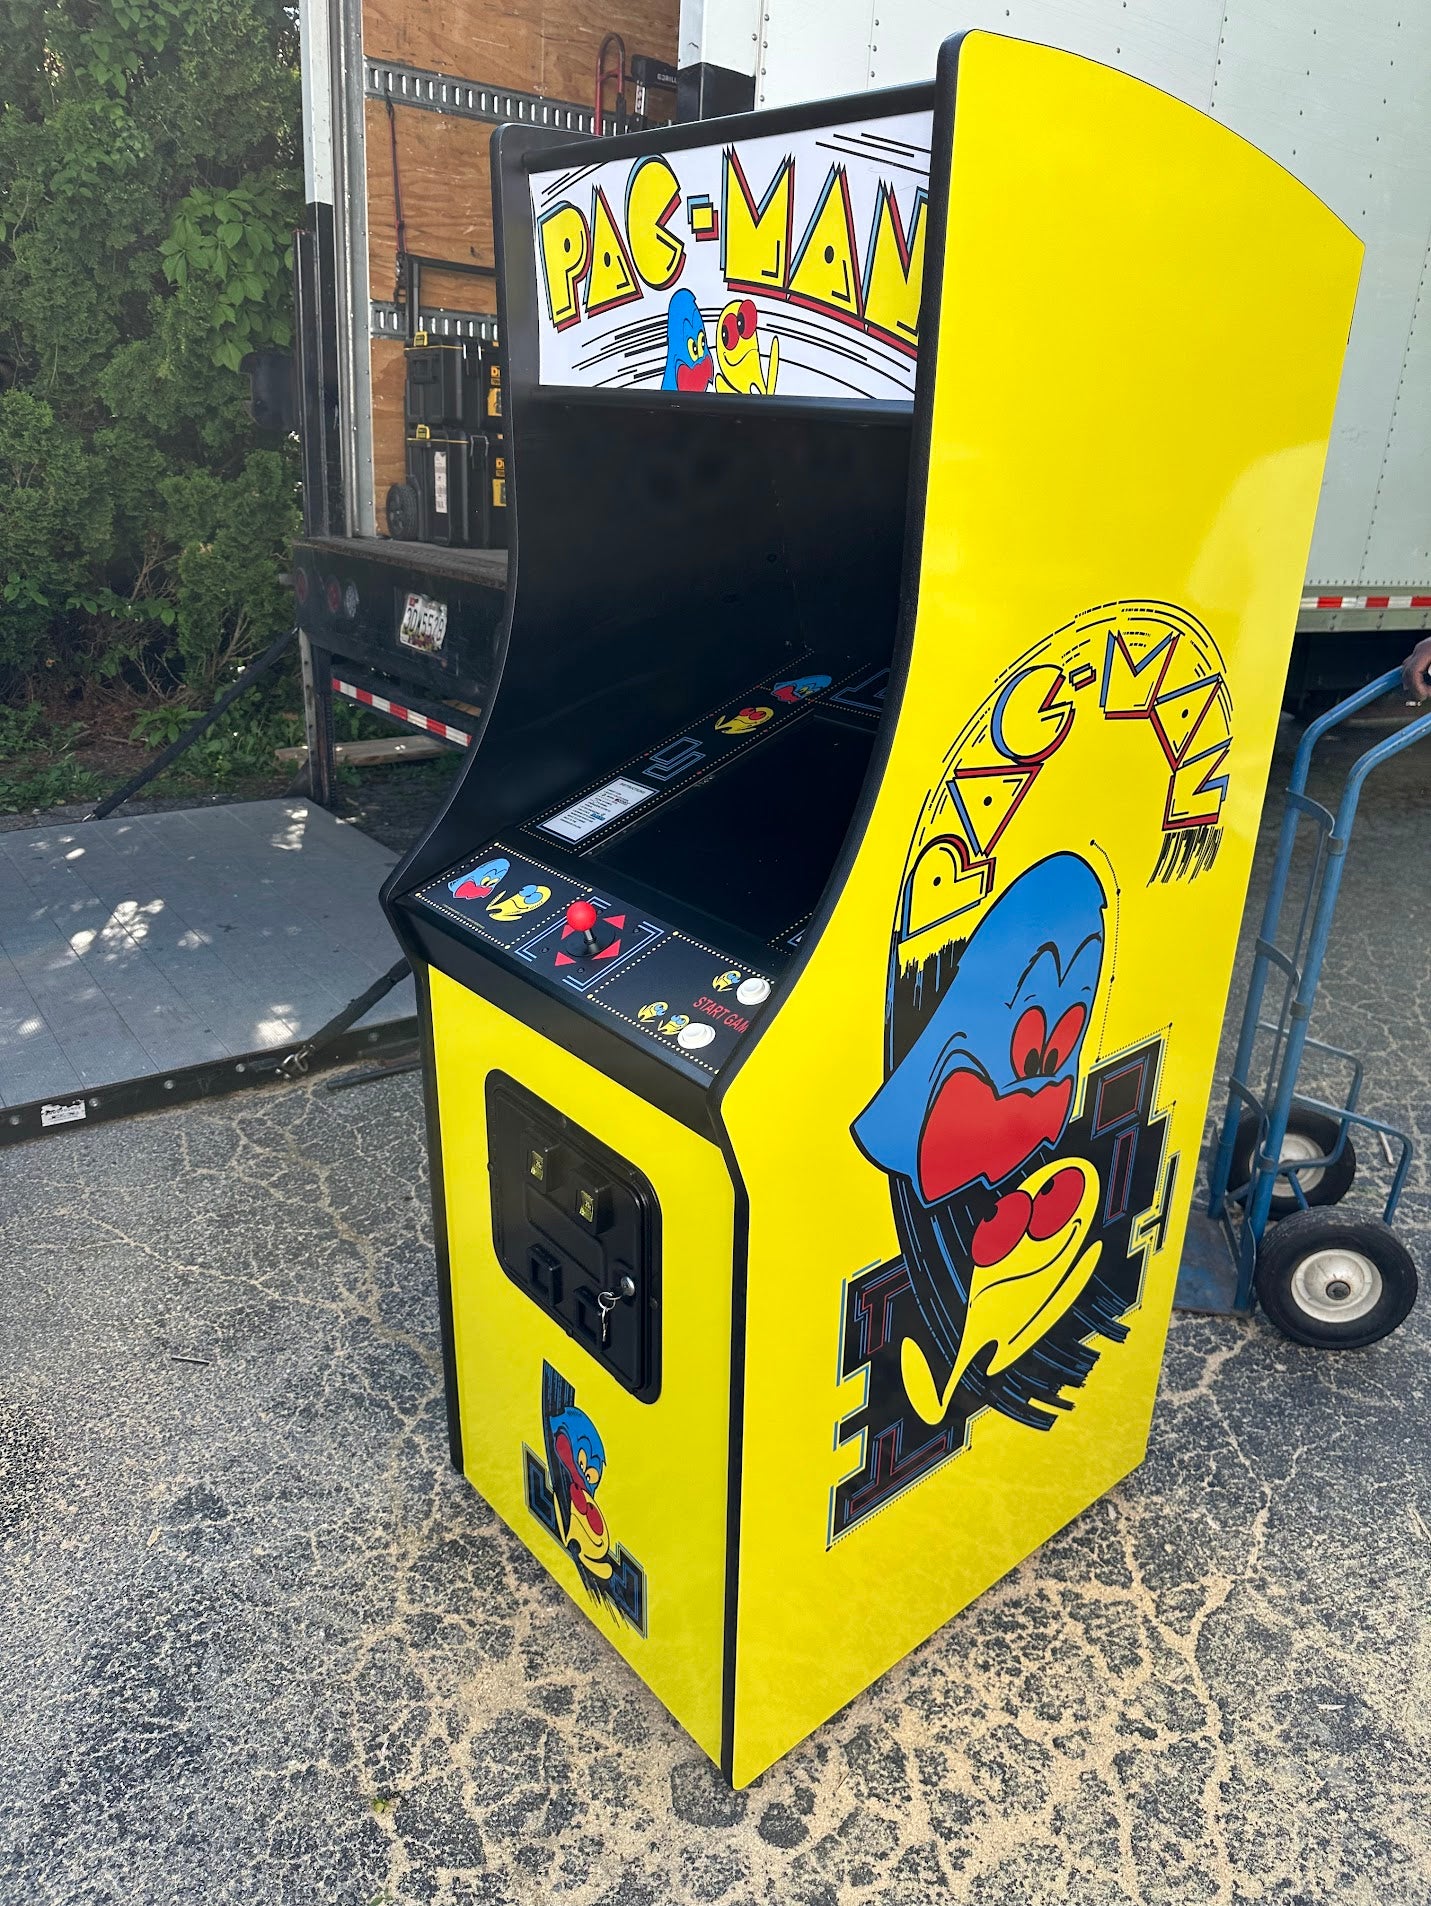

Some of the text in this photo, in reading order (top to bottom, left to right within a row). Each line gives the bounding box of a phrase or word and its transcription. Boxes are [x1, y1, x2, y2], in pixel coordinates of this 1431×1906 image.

[536, 142, 929, 360] PAC-MAN
[902, 628, 1234, 942] PAC-MAN
[692, 996, 731, 1020] START
